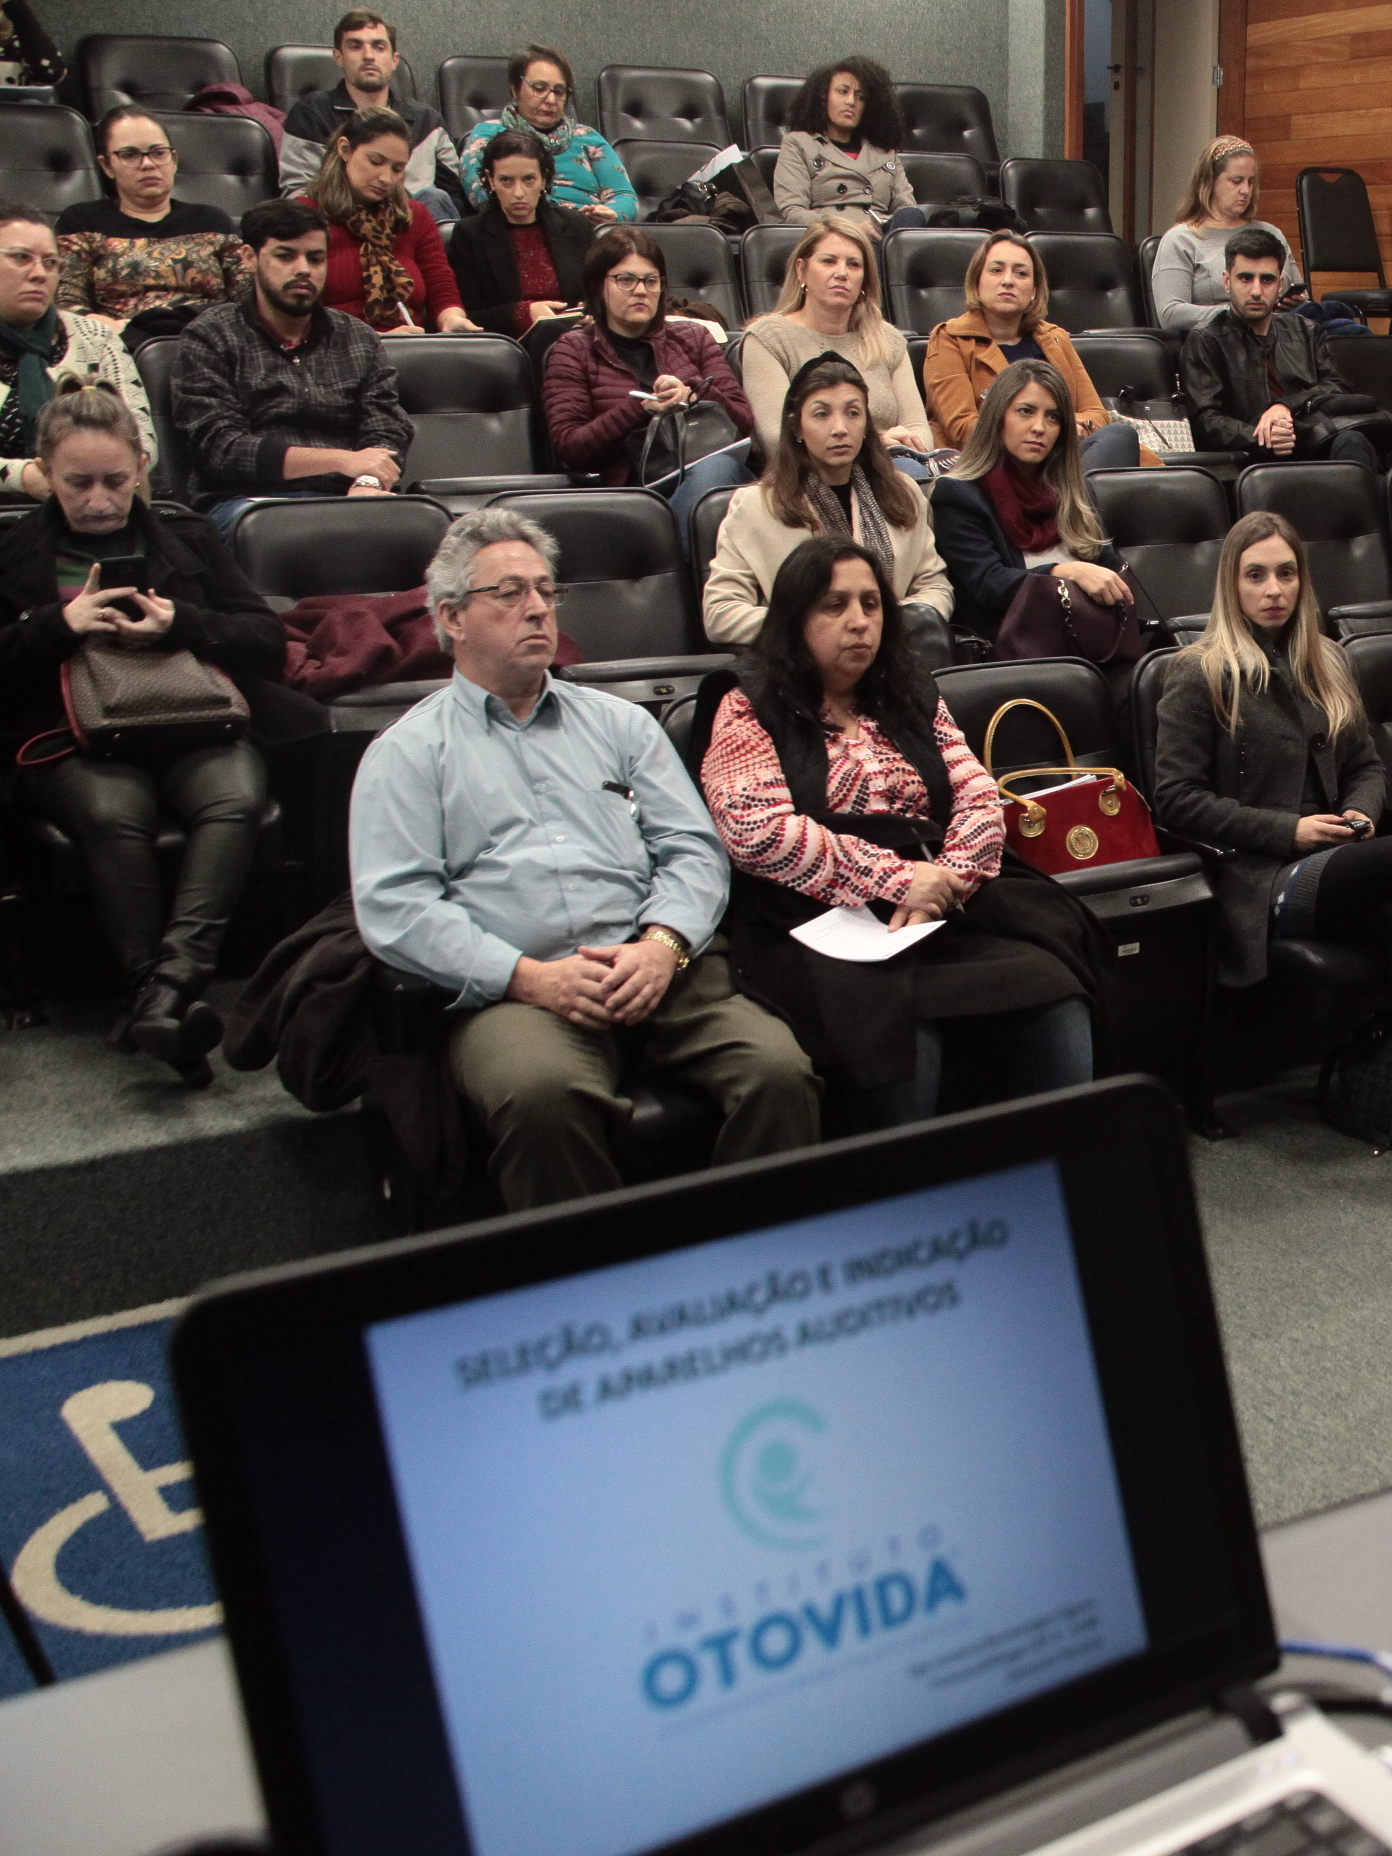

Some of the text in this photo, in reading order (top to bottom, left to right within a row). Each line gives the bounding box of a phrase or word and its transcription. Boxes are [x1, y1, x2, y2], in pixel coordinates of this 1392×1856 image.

[626, 1269, 815, 1341] AVALIAÇÃO
[816, 1261, 836, 1294] E
[841, 1216, 1011, 1285] INDICAÇÃO
[537, 1280, 962, 1421] DE APARELHOS AUDITIVOS
[640, 1556, 967, 1712] OTOVIDA
